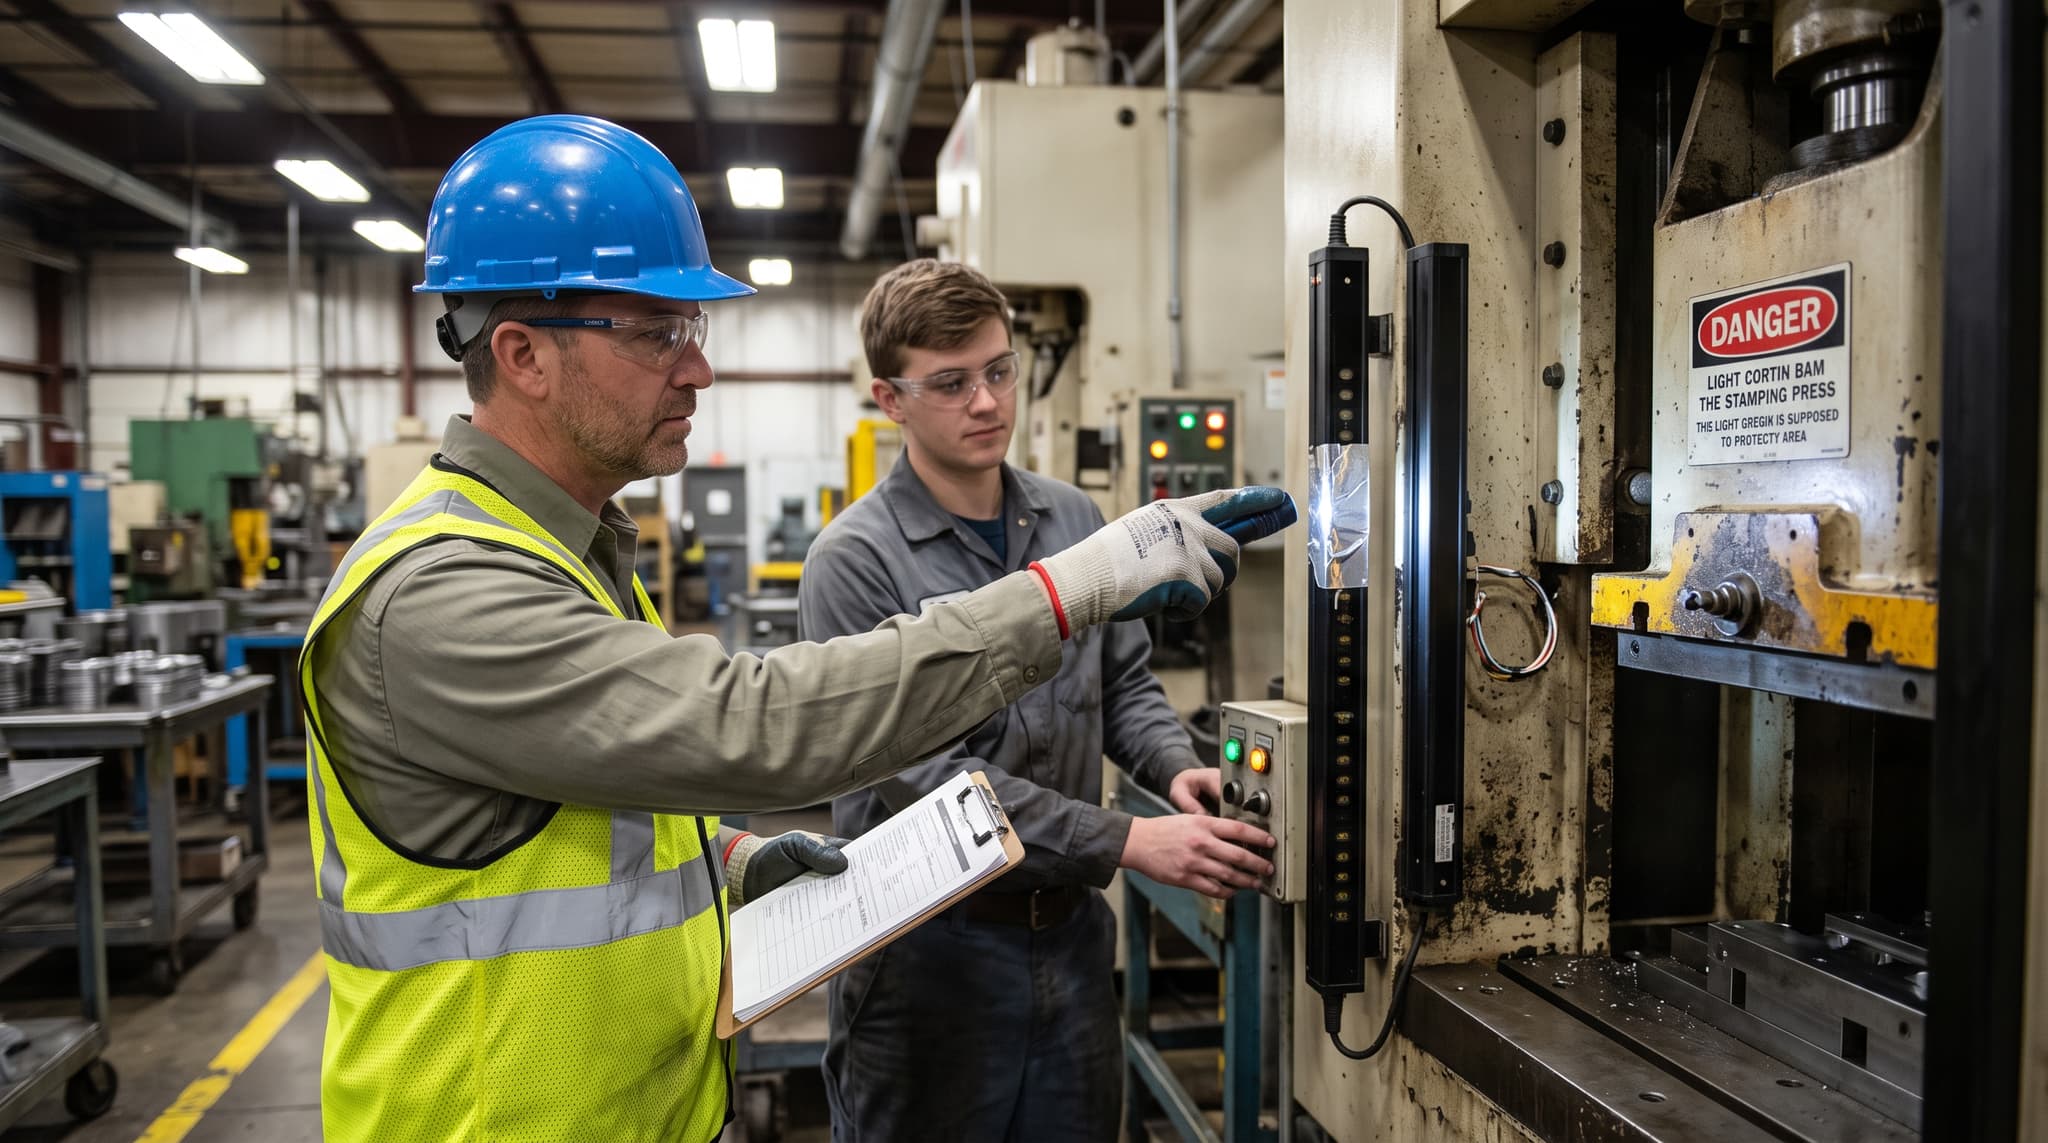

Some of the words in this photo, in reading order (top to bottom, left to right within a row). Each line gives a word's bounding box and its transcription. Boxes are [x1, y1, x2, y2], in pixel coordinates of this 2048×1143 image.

[1711, 296, 1821, 348] DANGER
[1707, 372, 1741, 390] LIGHT
[1745, 364, 1790, 385] CORTIN
[1795, 359, 1825, 379] BAM
[1699, 396, 1721, 412] THE
[1725, 387, 1787, 409] STAMPING
[1792, 381, 1836, 401] PRESS
[1715, 418, 1739, 432] LIGHT
[1776, 414, 1785, 426] IS
[1787, 408, 1839, 425] SUPPOSED
[1721, 436, 1732, 448] TO
[1734, 432, 1780, 447] PROTECTY
[1782, 430, 1807, 443] AREA
